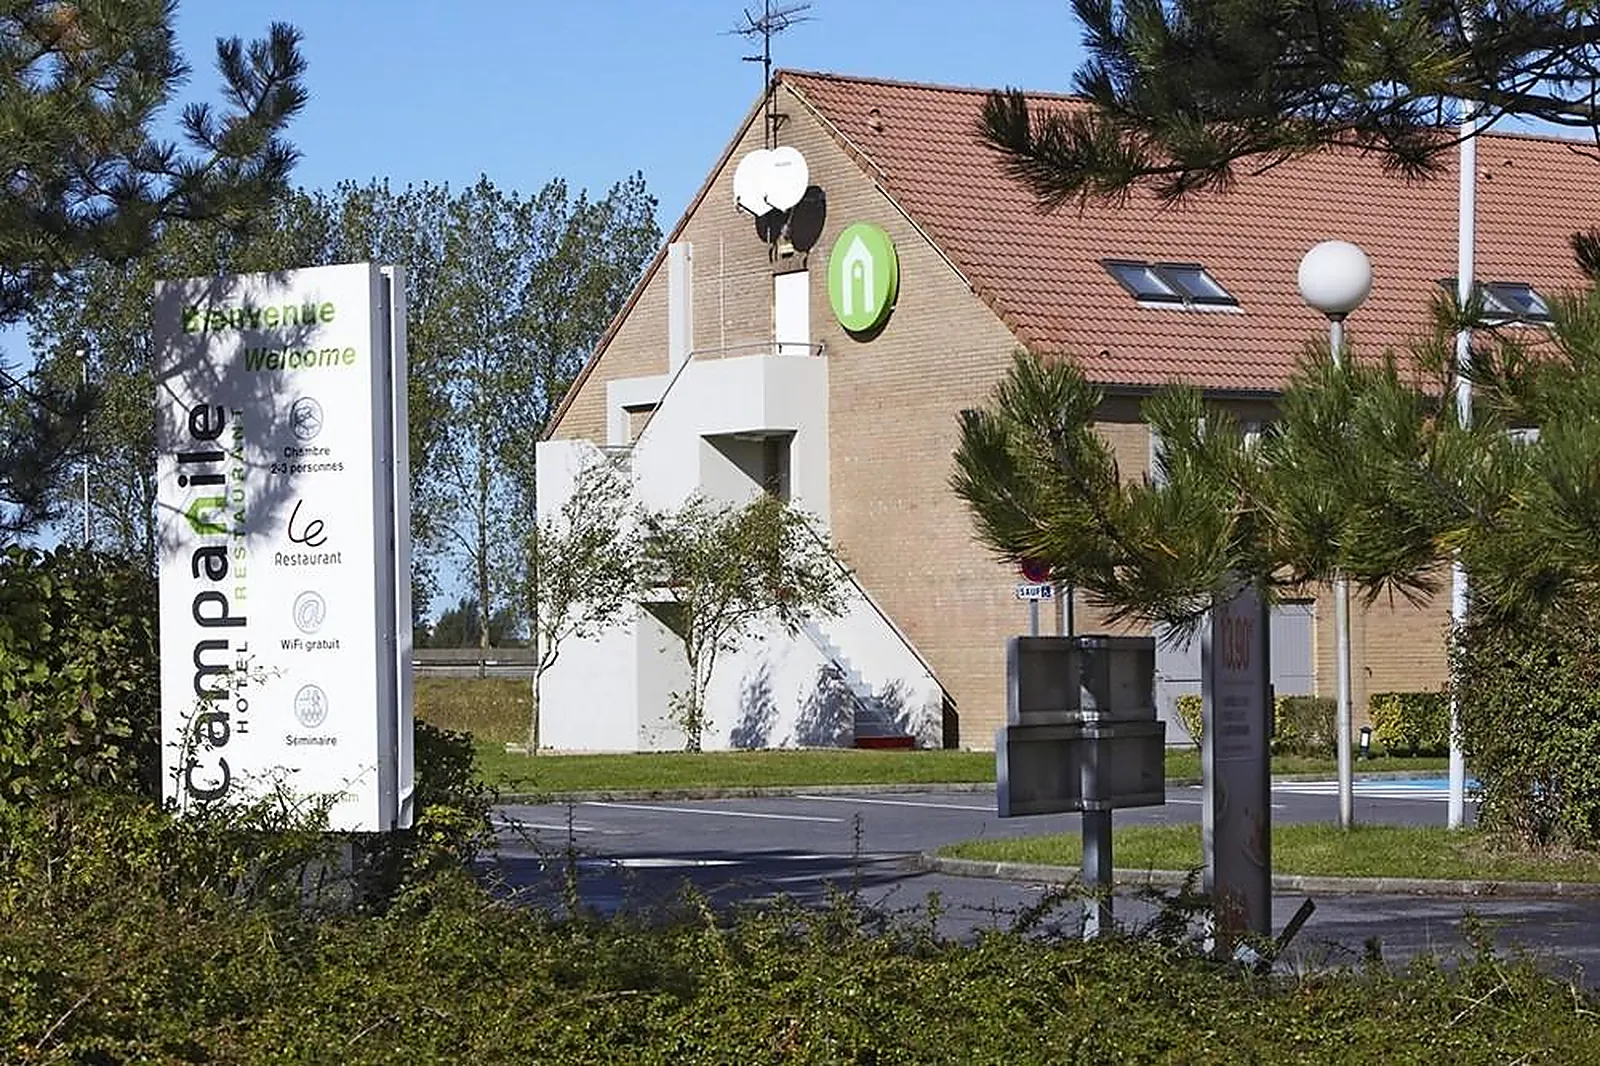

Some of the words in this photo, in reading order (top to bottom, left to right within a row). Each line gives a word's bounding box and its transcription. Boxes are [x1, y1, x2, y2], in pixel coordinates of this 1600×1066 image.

[245, 346, 356, 372] Welcome
[283, 445, 331, 458] Chambre
[269, 462, 287, 474] 2-3
[290, 462, 344, 475] personnes
[232, 407, 248, 600] RESTAURANT
[274, 551, 342, 566] Restaurant
[280, 638, 303, 650] WiFi
[304, 638, 341, 652] gratuit
